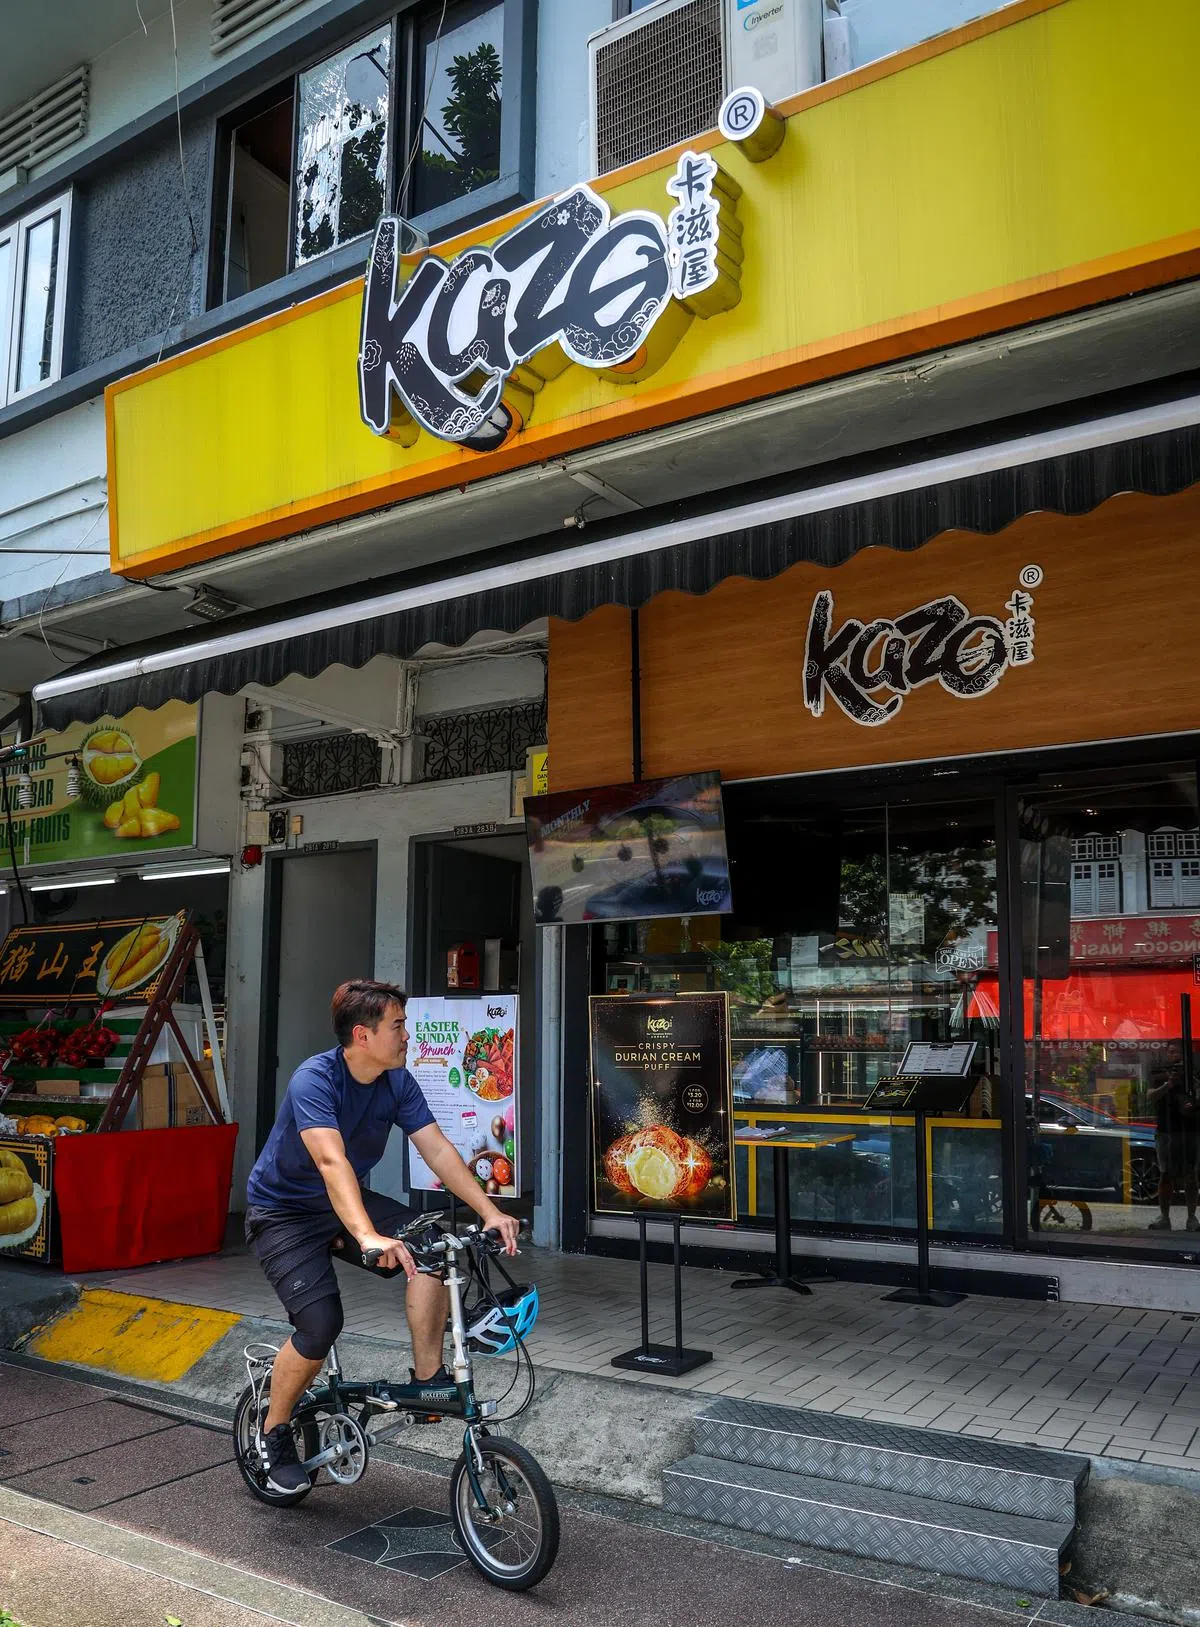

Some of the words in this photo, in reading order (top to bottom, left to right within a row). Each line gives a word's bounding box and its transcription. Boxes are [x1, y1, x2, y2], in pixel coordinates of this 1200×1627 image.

[674, 159, 713, 288] 卡滋屋
[1008, 593, 1032, 662] 卡滋屋
[540, 799, 591, 837] MONTHLY
[31, 813, 70, 845] FRUITS
[940, 953, 979, 969] OPEN
[415, 1021, 459, 1032] EASTER
[415, 1032, 460, 1043] SUNDAY
[419, 1041, 456, 1058] Brunch
[615, 1053, 657, 1061] DURIAN
[661, 1052, 701, 1061] CREAM
[644, 1063, 670, 1071] PUFF
